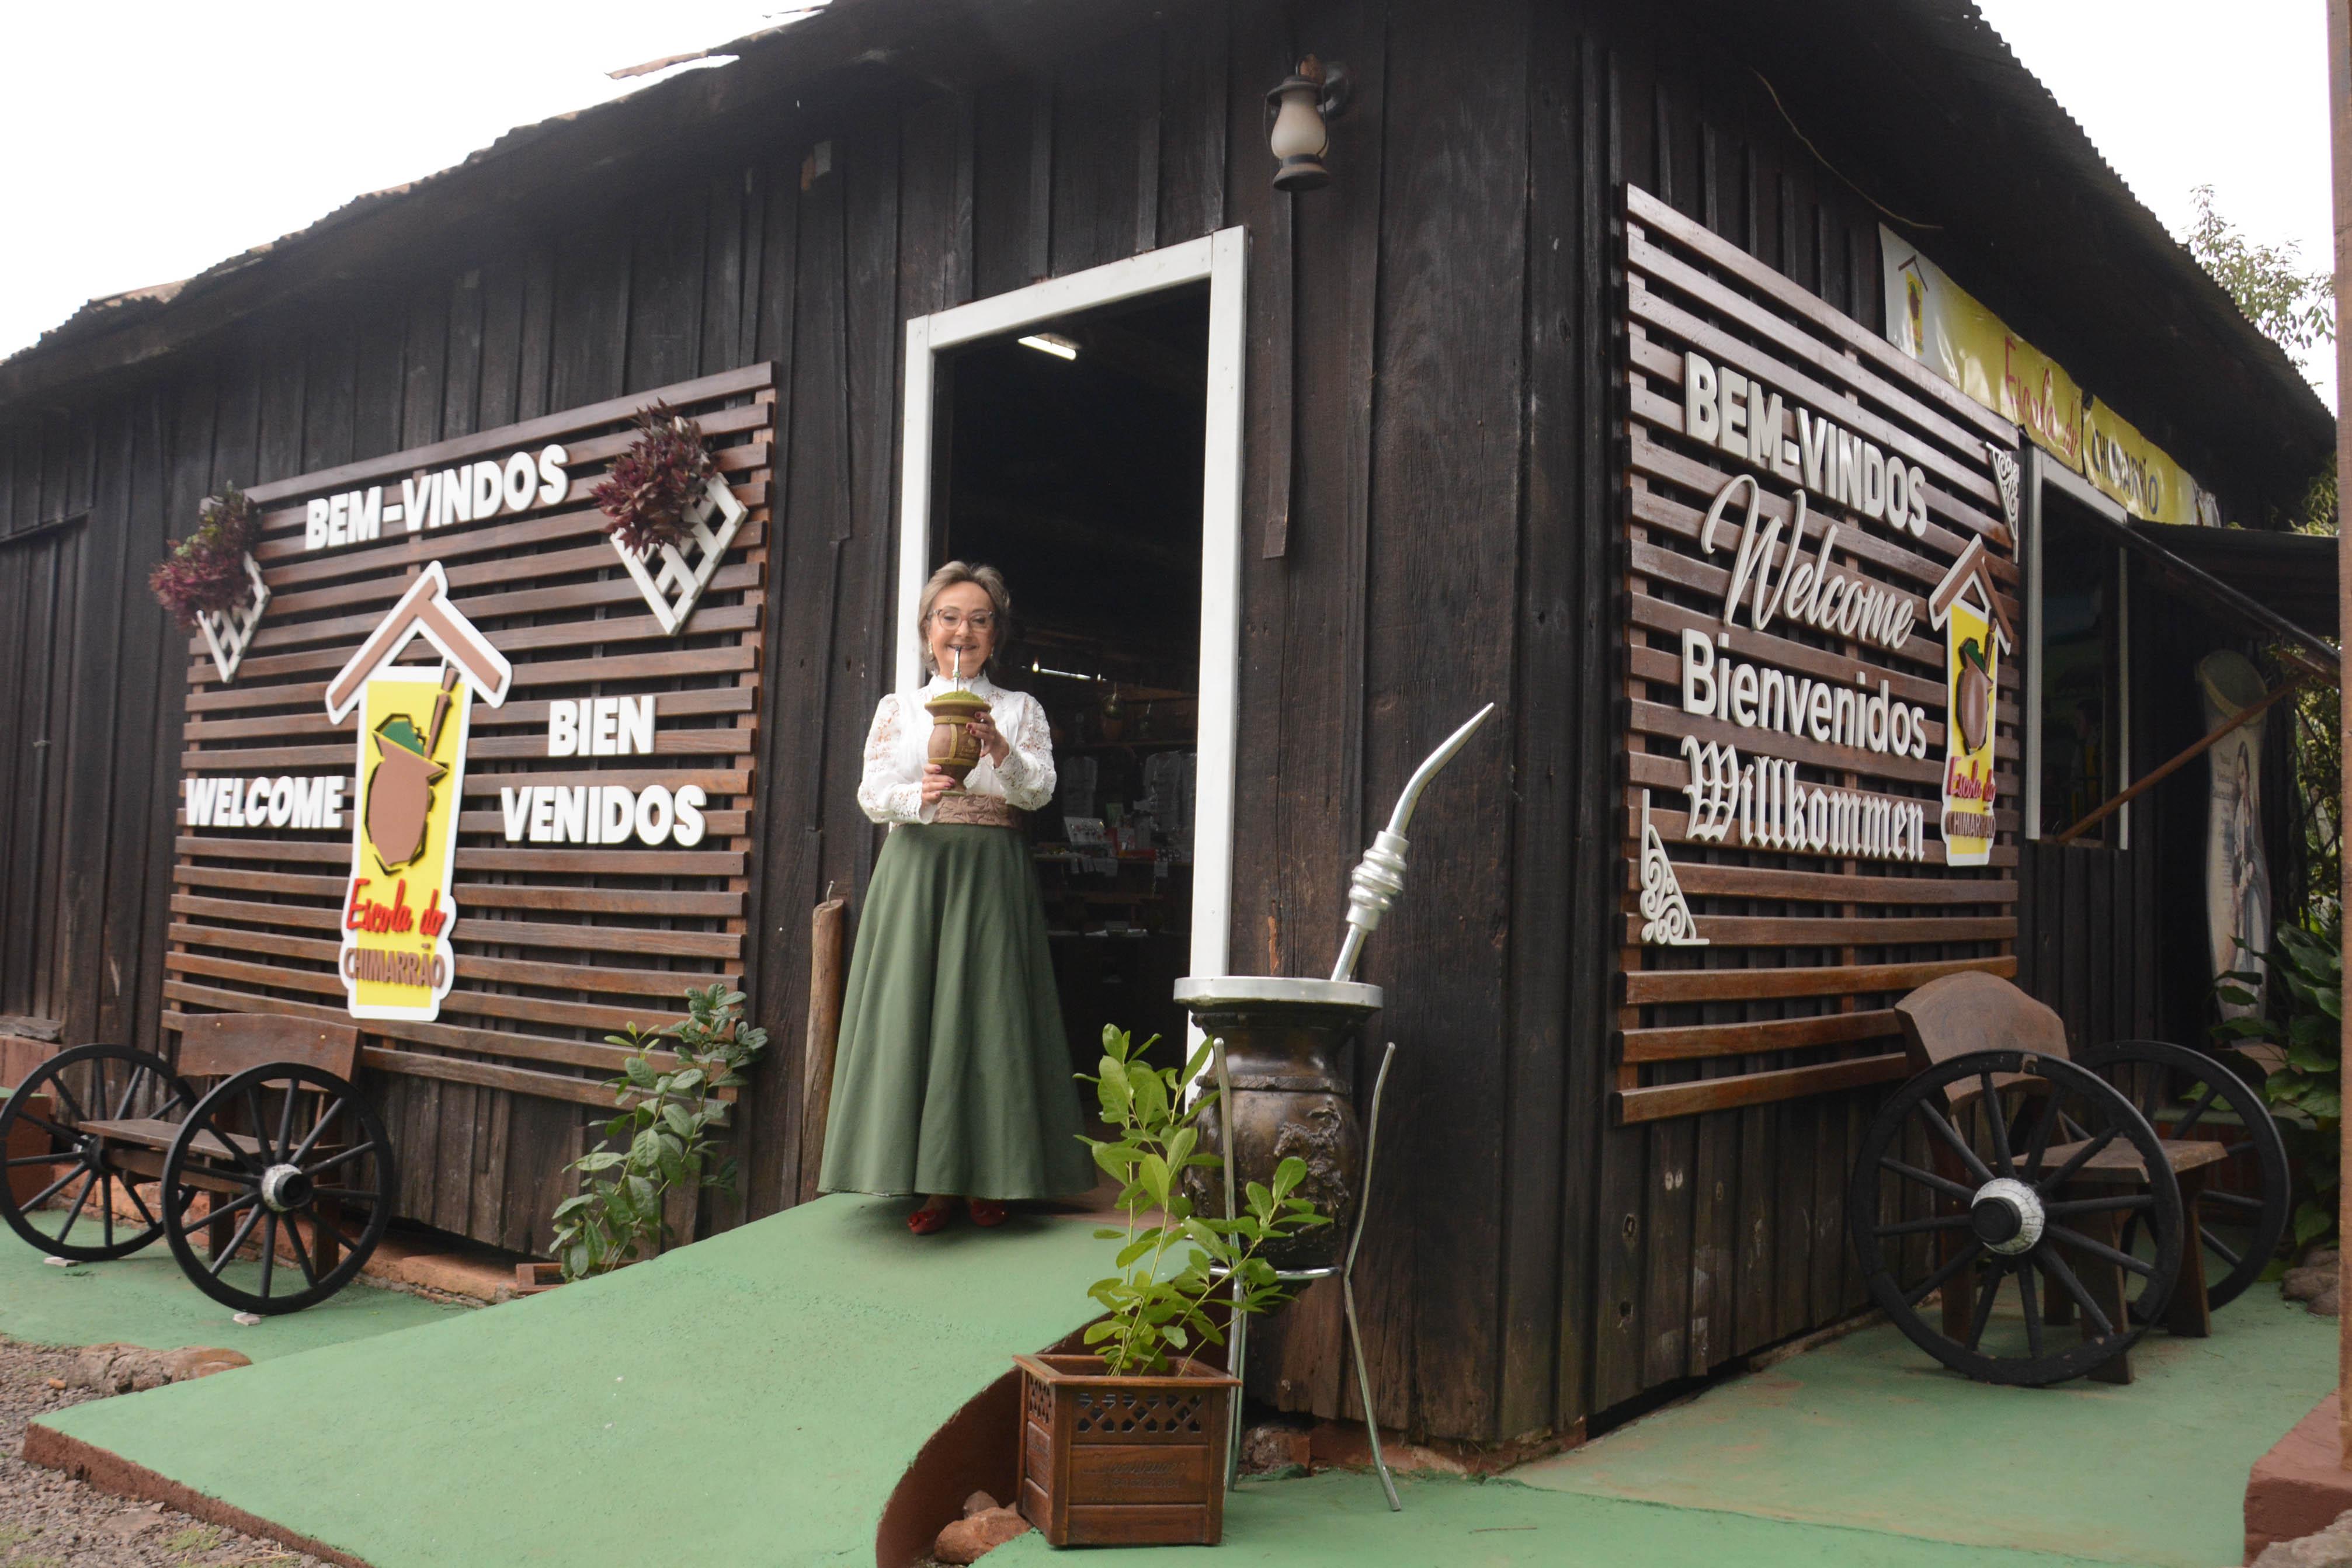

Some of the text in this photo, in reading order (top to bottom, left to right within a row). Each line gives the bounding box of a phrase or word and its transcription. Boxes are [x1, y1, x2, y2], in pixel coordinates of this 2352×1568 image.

[1685, 351, 1927, 537] BEM-VINDOS
[2092, 429, 2159, 515] CHIARO
[305, 444, 569, 551] BEM-VINDOS
[1701, 474, 1916, 649] Welcome
[548, 695, 655, 757] BIEN
[1682, 628, 1927, 760] Bienvenidos
[185, 775, 346, 829] WELCOME
[501, 784, 707, 847] VENIDOS
[1680, 735, 1925, 863] Willkommen
[1946, 756, 1997, 802] Escola do
[346, 878, 447, 937] Escola do
[343, 943, 446, 989] CHIMARRÃO
